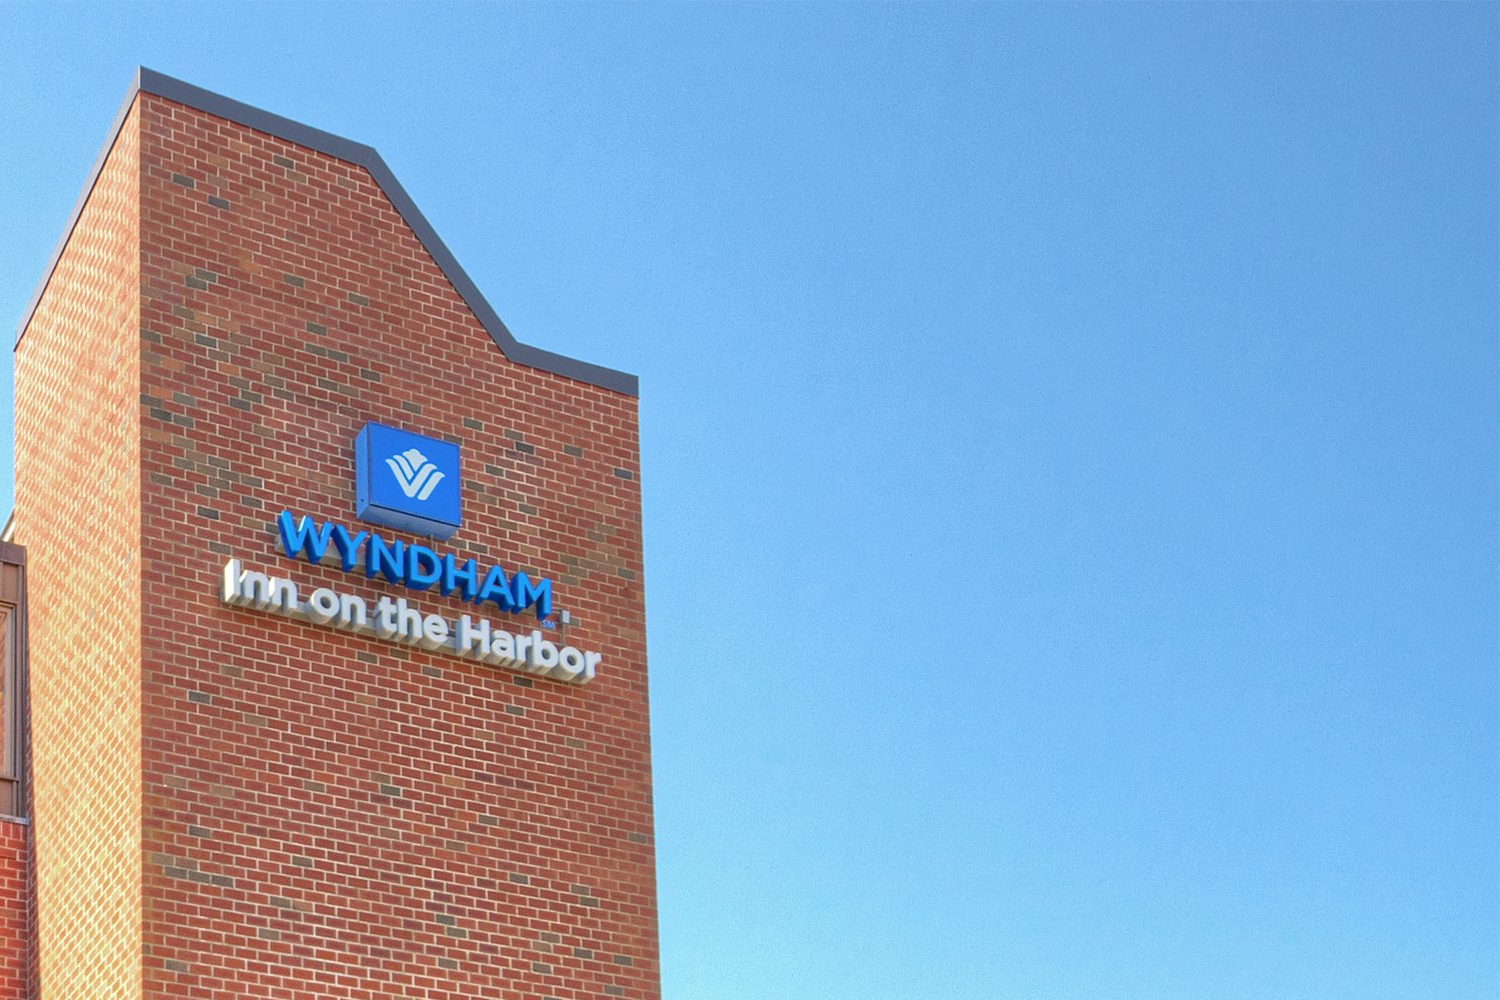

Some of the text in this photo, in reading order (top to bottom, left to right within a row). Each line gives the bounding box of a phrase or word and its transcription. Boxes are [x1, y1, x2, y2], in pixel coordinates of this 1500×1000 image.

[224, 558, 602, 683] Inn on the Harbor
[278, 510, 552, 620] WYNDHAM
